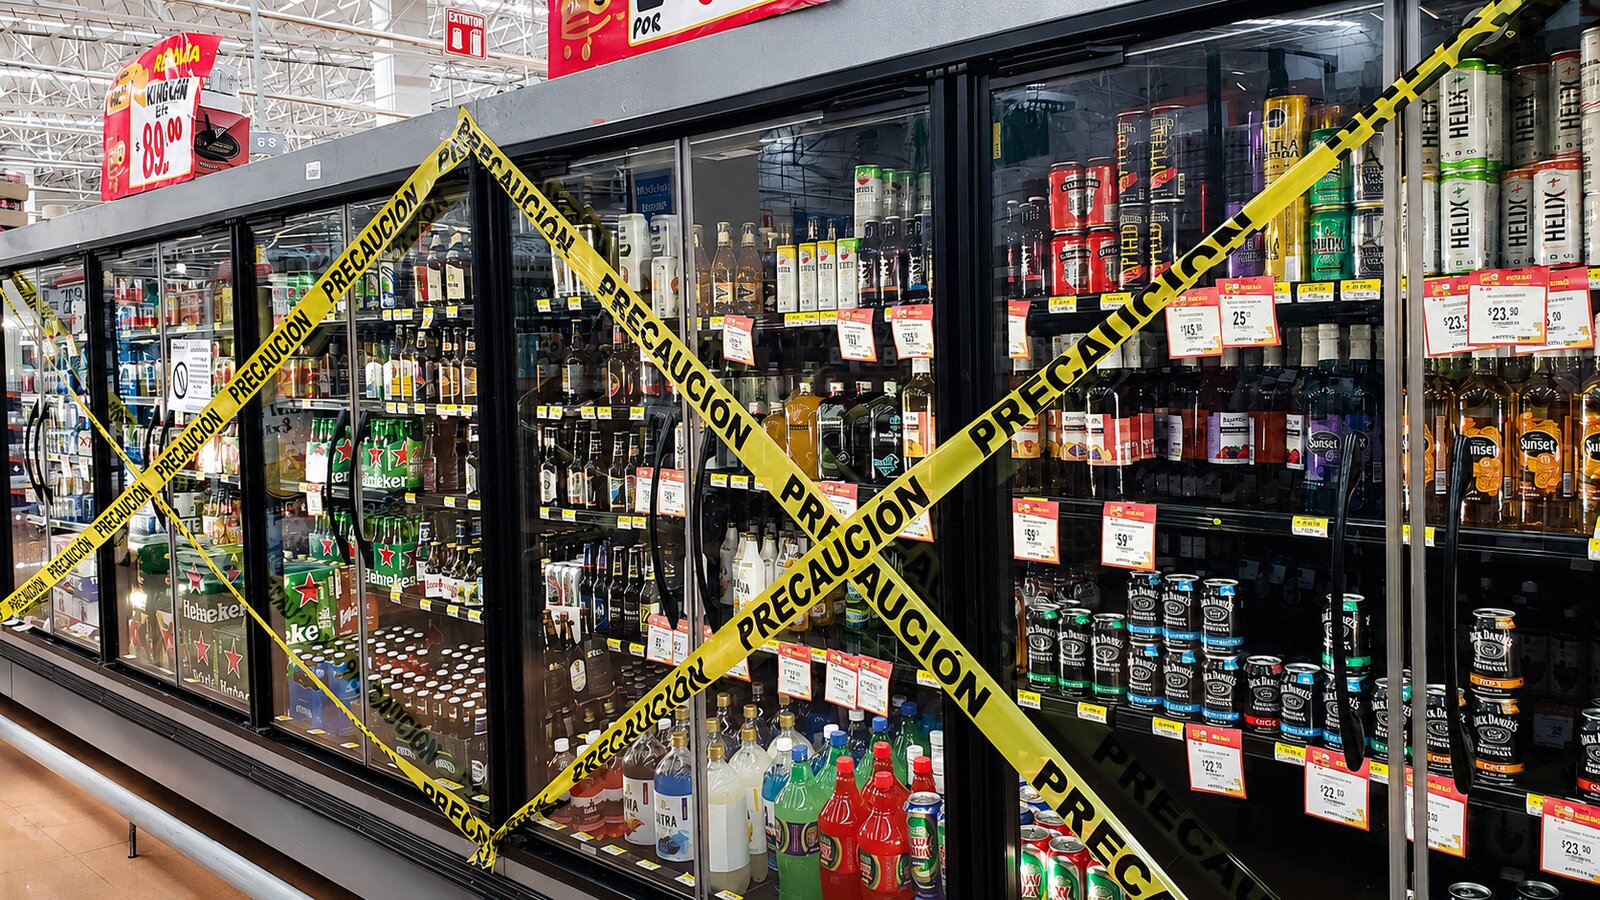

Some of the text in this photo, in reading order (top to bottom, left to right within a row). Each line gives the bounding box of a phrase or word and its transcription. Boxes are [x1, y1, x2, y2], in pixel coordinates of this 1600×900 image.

[448, 12, 484, 28] EXTINTOR
[633, 13, 662, 39] POR
[1449, 88, 1468, 139] HELIX
[1450, 199, 1470, 249] HELIX
[1508, 198, 1527, 247] HELIX
[1545, 188, 1567, 242] HELIX
[321, 183, 420, 304] PRECAUCIÓN
[228, 309, 312, 405] PRECAUCIÓN
[597, 273, 752, 452] PRECAUCIÓN
[154, 408, 223, 481] PRECAUCIÓN
[1308, 437, 1338, 449] Sunset
[1470, 444, 1496, 455] nset
[1520, 437, 1555, 451] Sunset
[94, 482, 152, 538] PRECAUCIÓN
[736, 475, 931, 651] PRECAUCIÓN
[780, 474, 992, 718] PREAUCIÓN
[572, 657, 711, 783] PRECAUCIÓN
